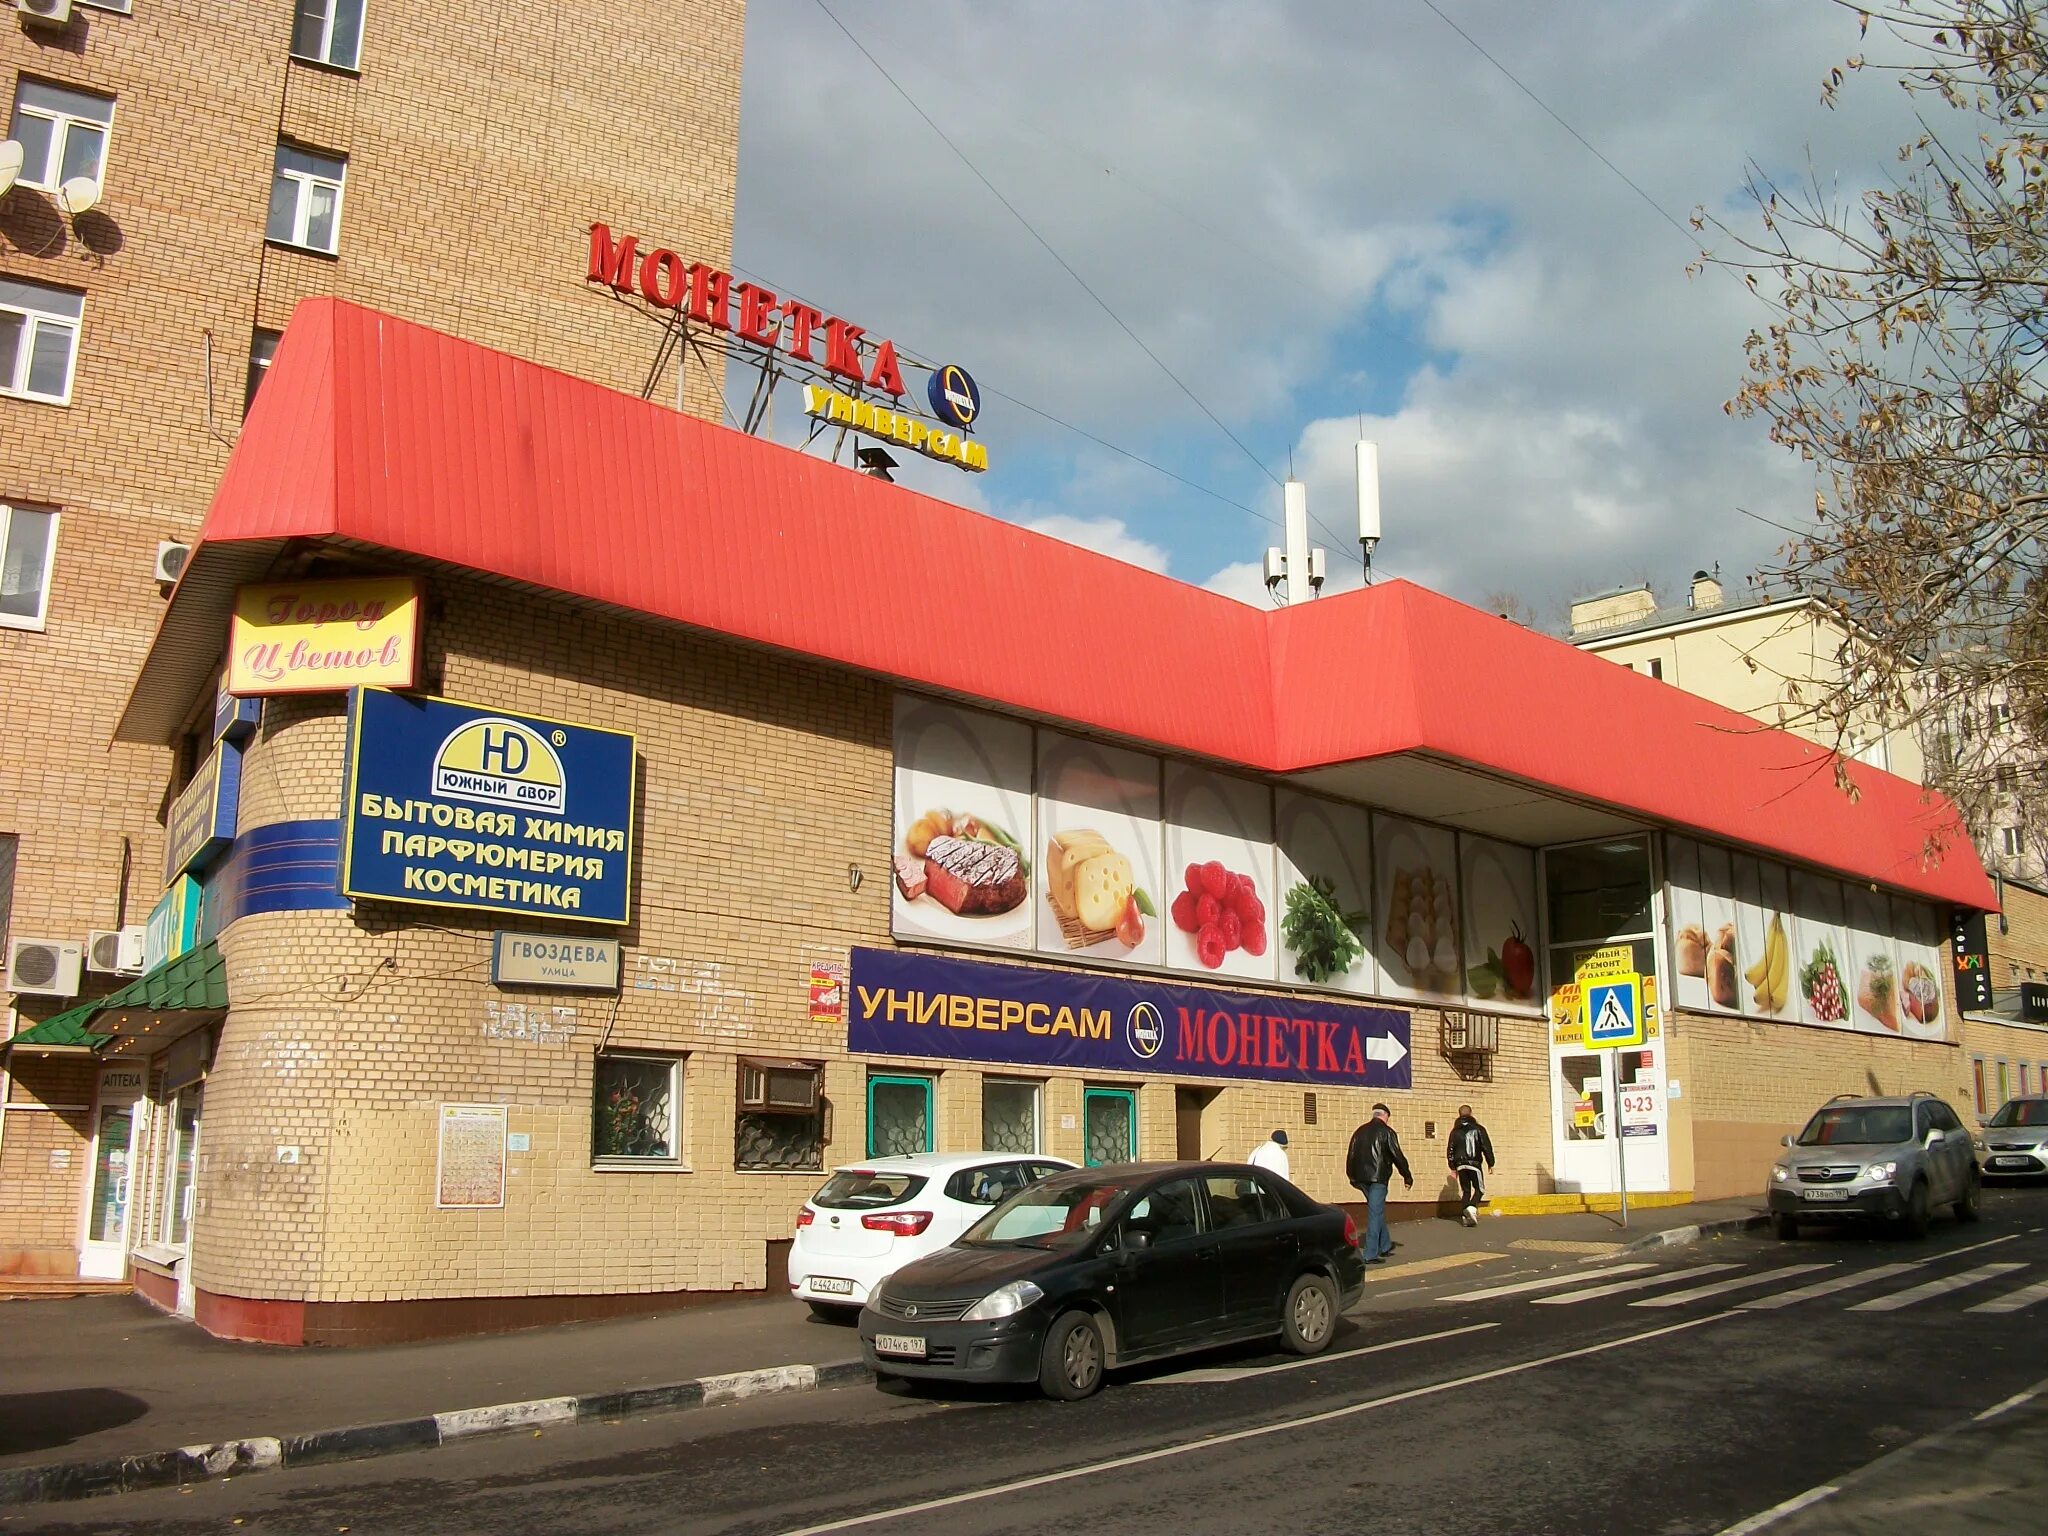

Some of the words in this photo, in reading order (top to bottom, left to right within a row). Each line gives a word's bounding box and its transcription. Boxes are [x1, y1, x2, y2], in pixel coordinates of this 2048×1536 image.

[586, 221, 906, 397] МОНЕТКА
[802, 383, 989, 473] УНИВЕРСАМ
[268, 594, 386, 631] Город
[243, 635, 402, 682] Цветов
[443, 773, 508, 796] ЮЖНЫЙ
[516, 787, 557, 803] ДВОР
[361, 794, 516, 837] БЫТОВАЯ
[524, 817, 625, 852] ХИМИЯ
[382, 831, 604, 881] ПАРФЮМЕРИЯ
[404, 867, 581, 910] КОСМЕТИКА
[512, 941, 608, 965] ГВОЗДЕВА
[541, 966, 576, 978] УЛИЦА
[1575, 949, 1620, 961] СРОЧНЫЙ
[1585, 960, 1621, 970] РЕМОНТ
[856, 985, 1112, 1040] УНИВЕРСАМ
[1175, 1005, 1367, 1074] МОНЕТКА
[103, 1073, 141, 1088] АПТЕКА
[1624, 1096, 1653, 1113] 9-23
